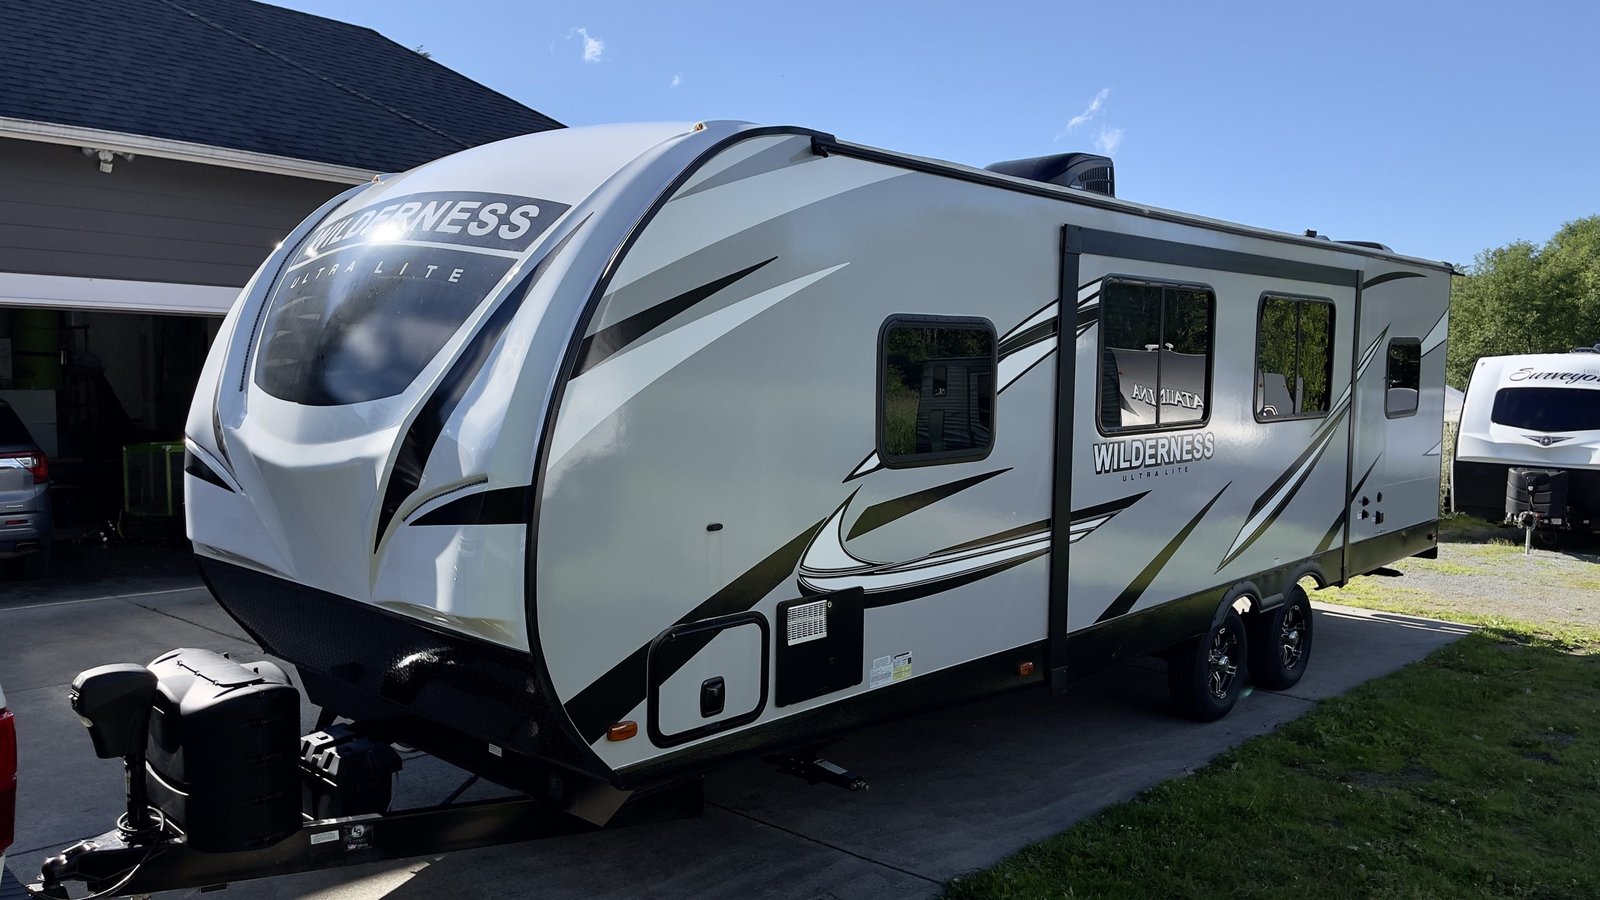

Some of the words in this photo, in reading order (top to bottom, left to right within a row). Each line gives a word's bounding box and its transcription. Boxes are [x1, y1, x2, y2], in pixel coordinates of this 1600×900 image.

[307, 200, 540, 251] WILDERNESS
[290, 260, 357, 289] ULTRA
[373, 260, 464, 283] LITE
[1509, 367, 1600, 384] Surveyo
[1093, 432, 1215, 475] WILDERNESS
